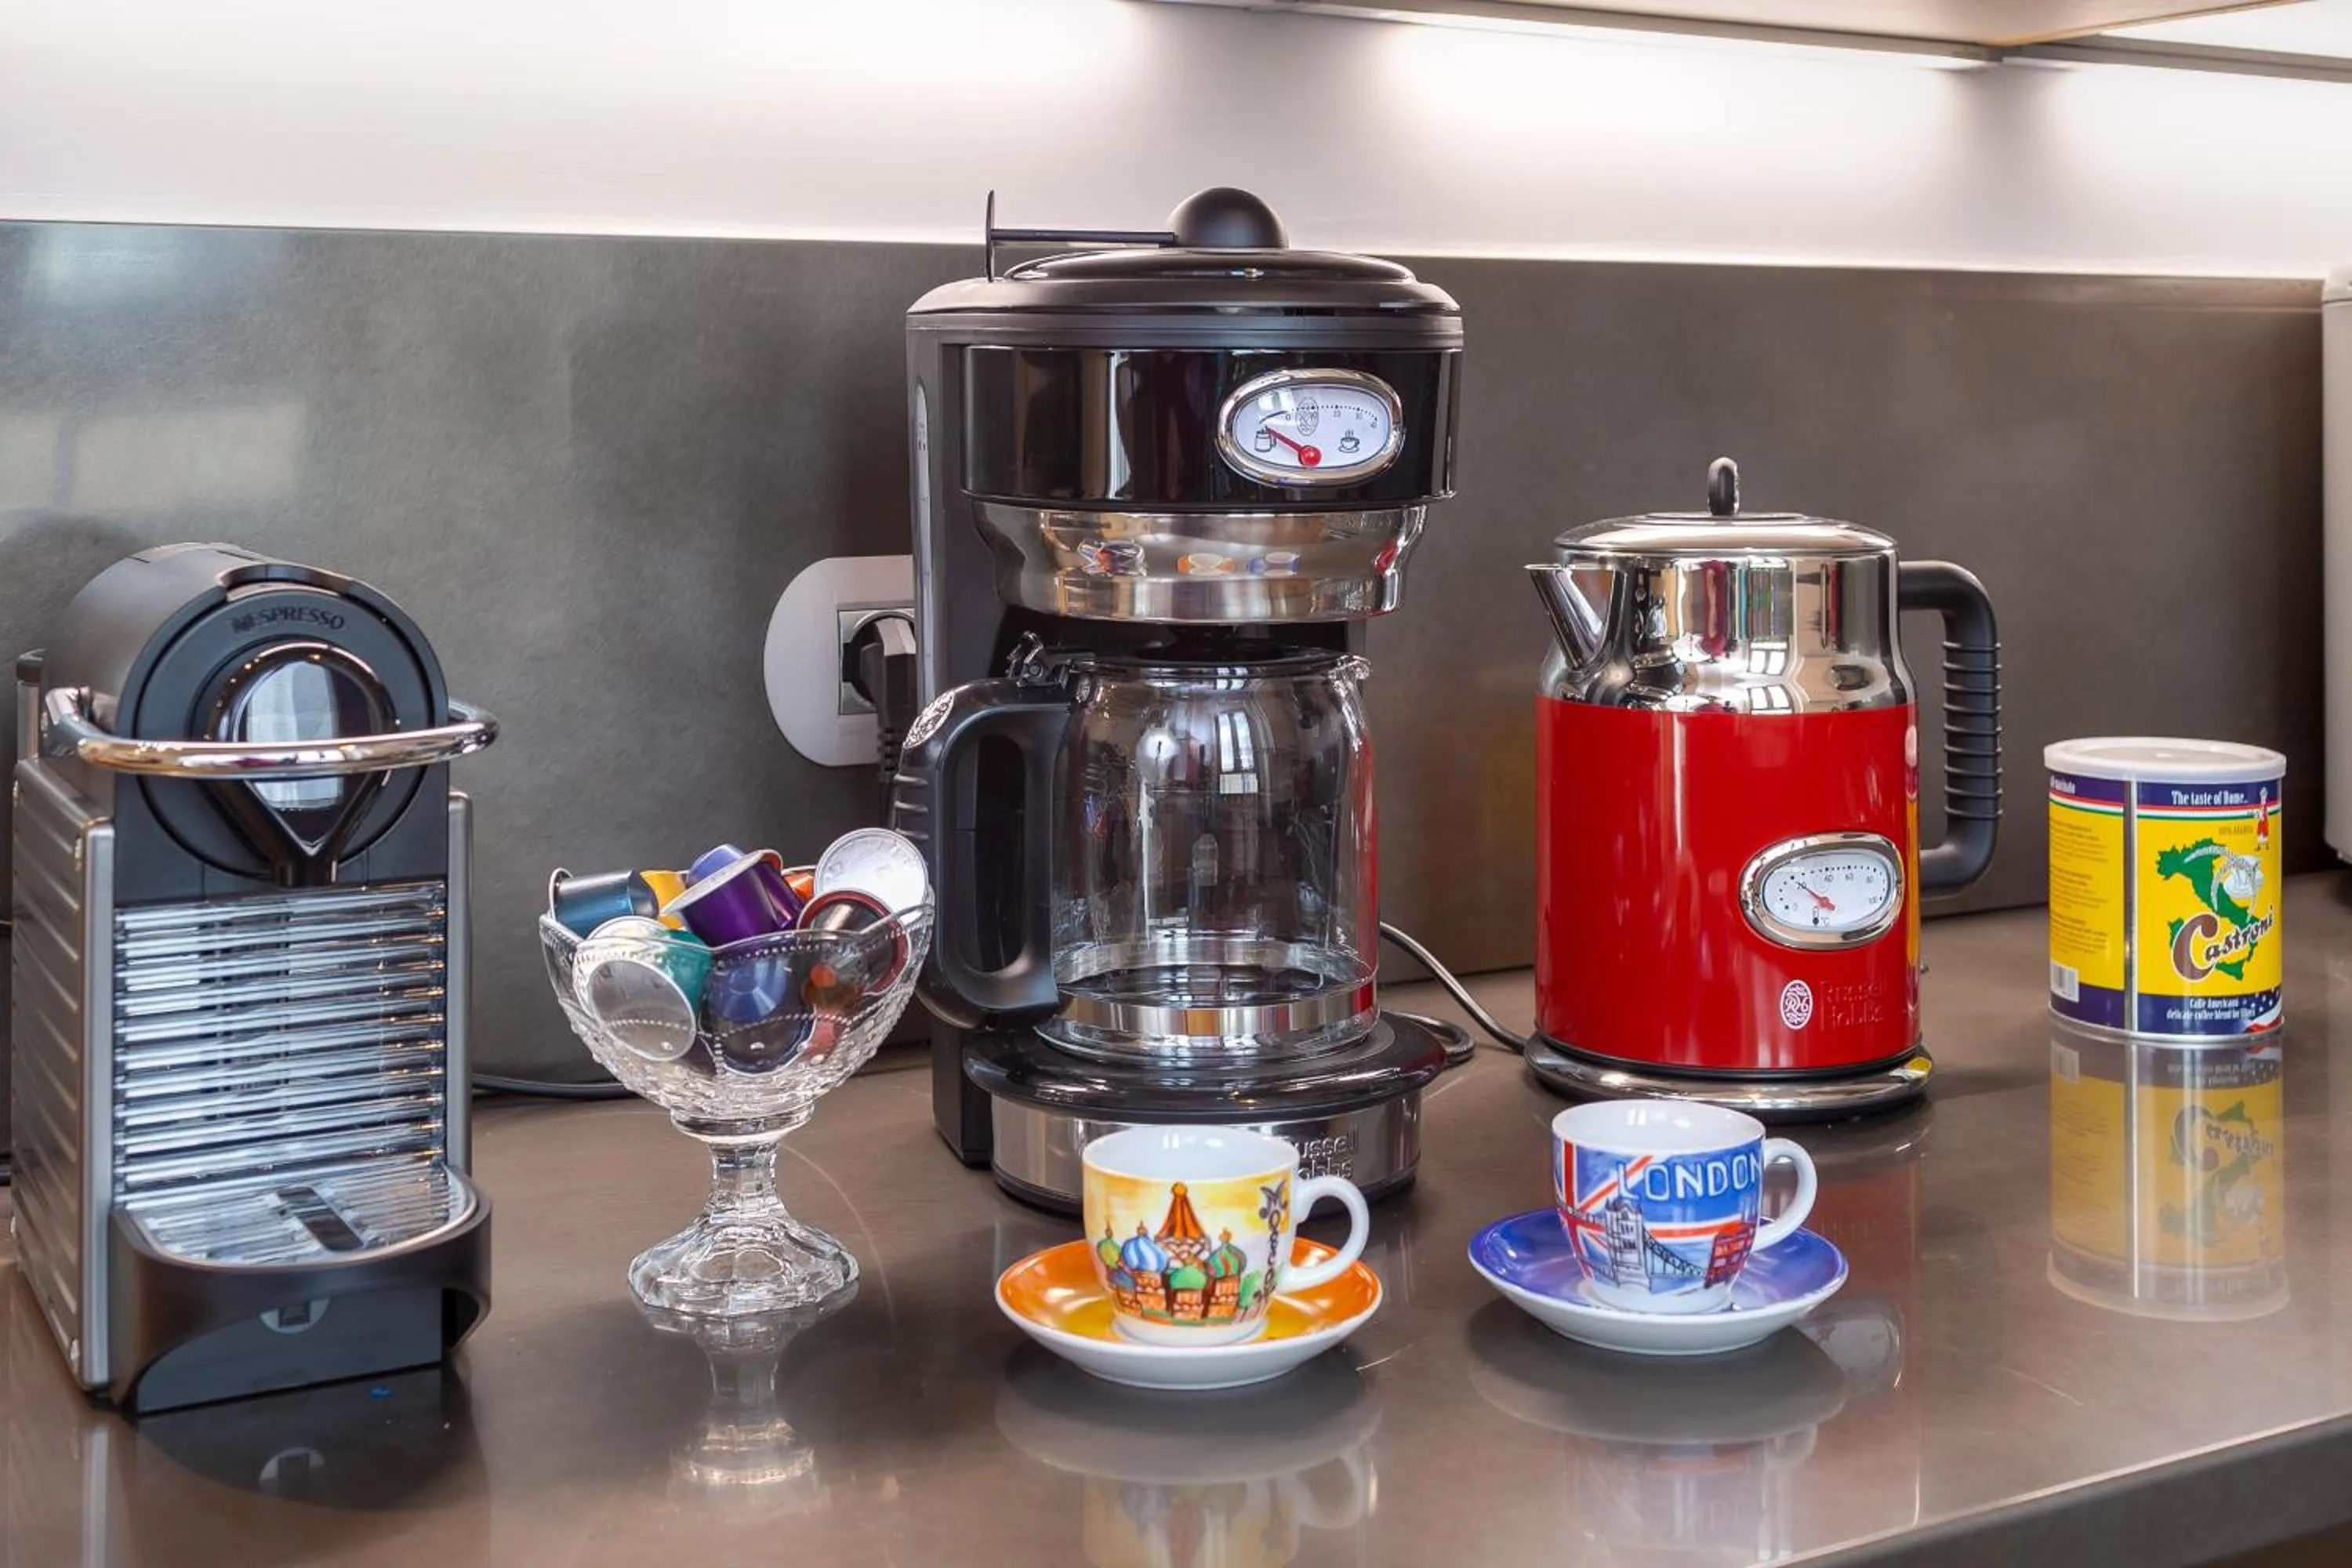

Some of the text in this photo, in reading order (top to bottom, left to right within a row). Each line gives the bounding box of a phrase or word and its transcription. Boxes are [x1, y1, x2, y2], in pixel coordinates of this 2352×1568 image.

[231, 605, 345, 633] NESPRESSO
[2171, 789, 2190, 806] The
[2190, 790, 2212, 806] taste
[2213, 789, 2223, 806] of
[2172, 903, 2273, 982] Castroni
[1294, 1129, 1358, 1159] ussell
[1298, 1154, 1355, 1178] obbs
[1617, 1152, 1762, 1201] LONDON
